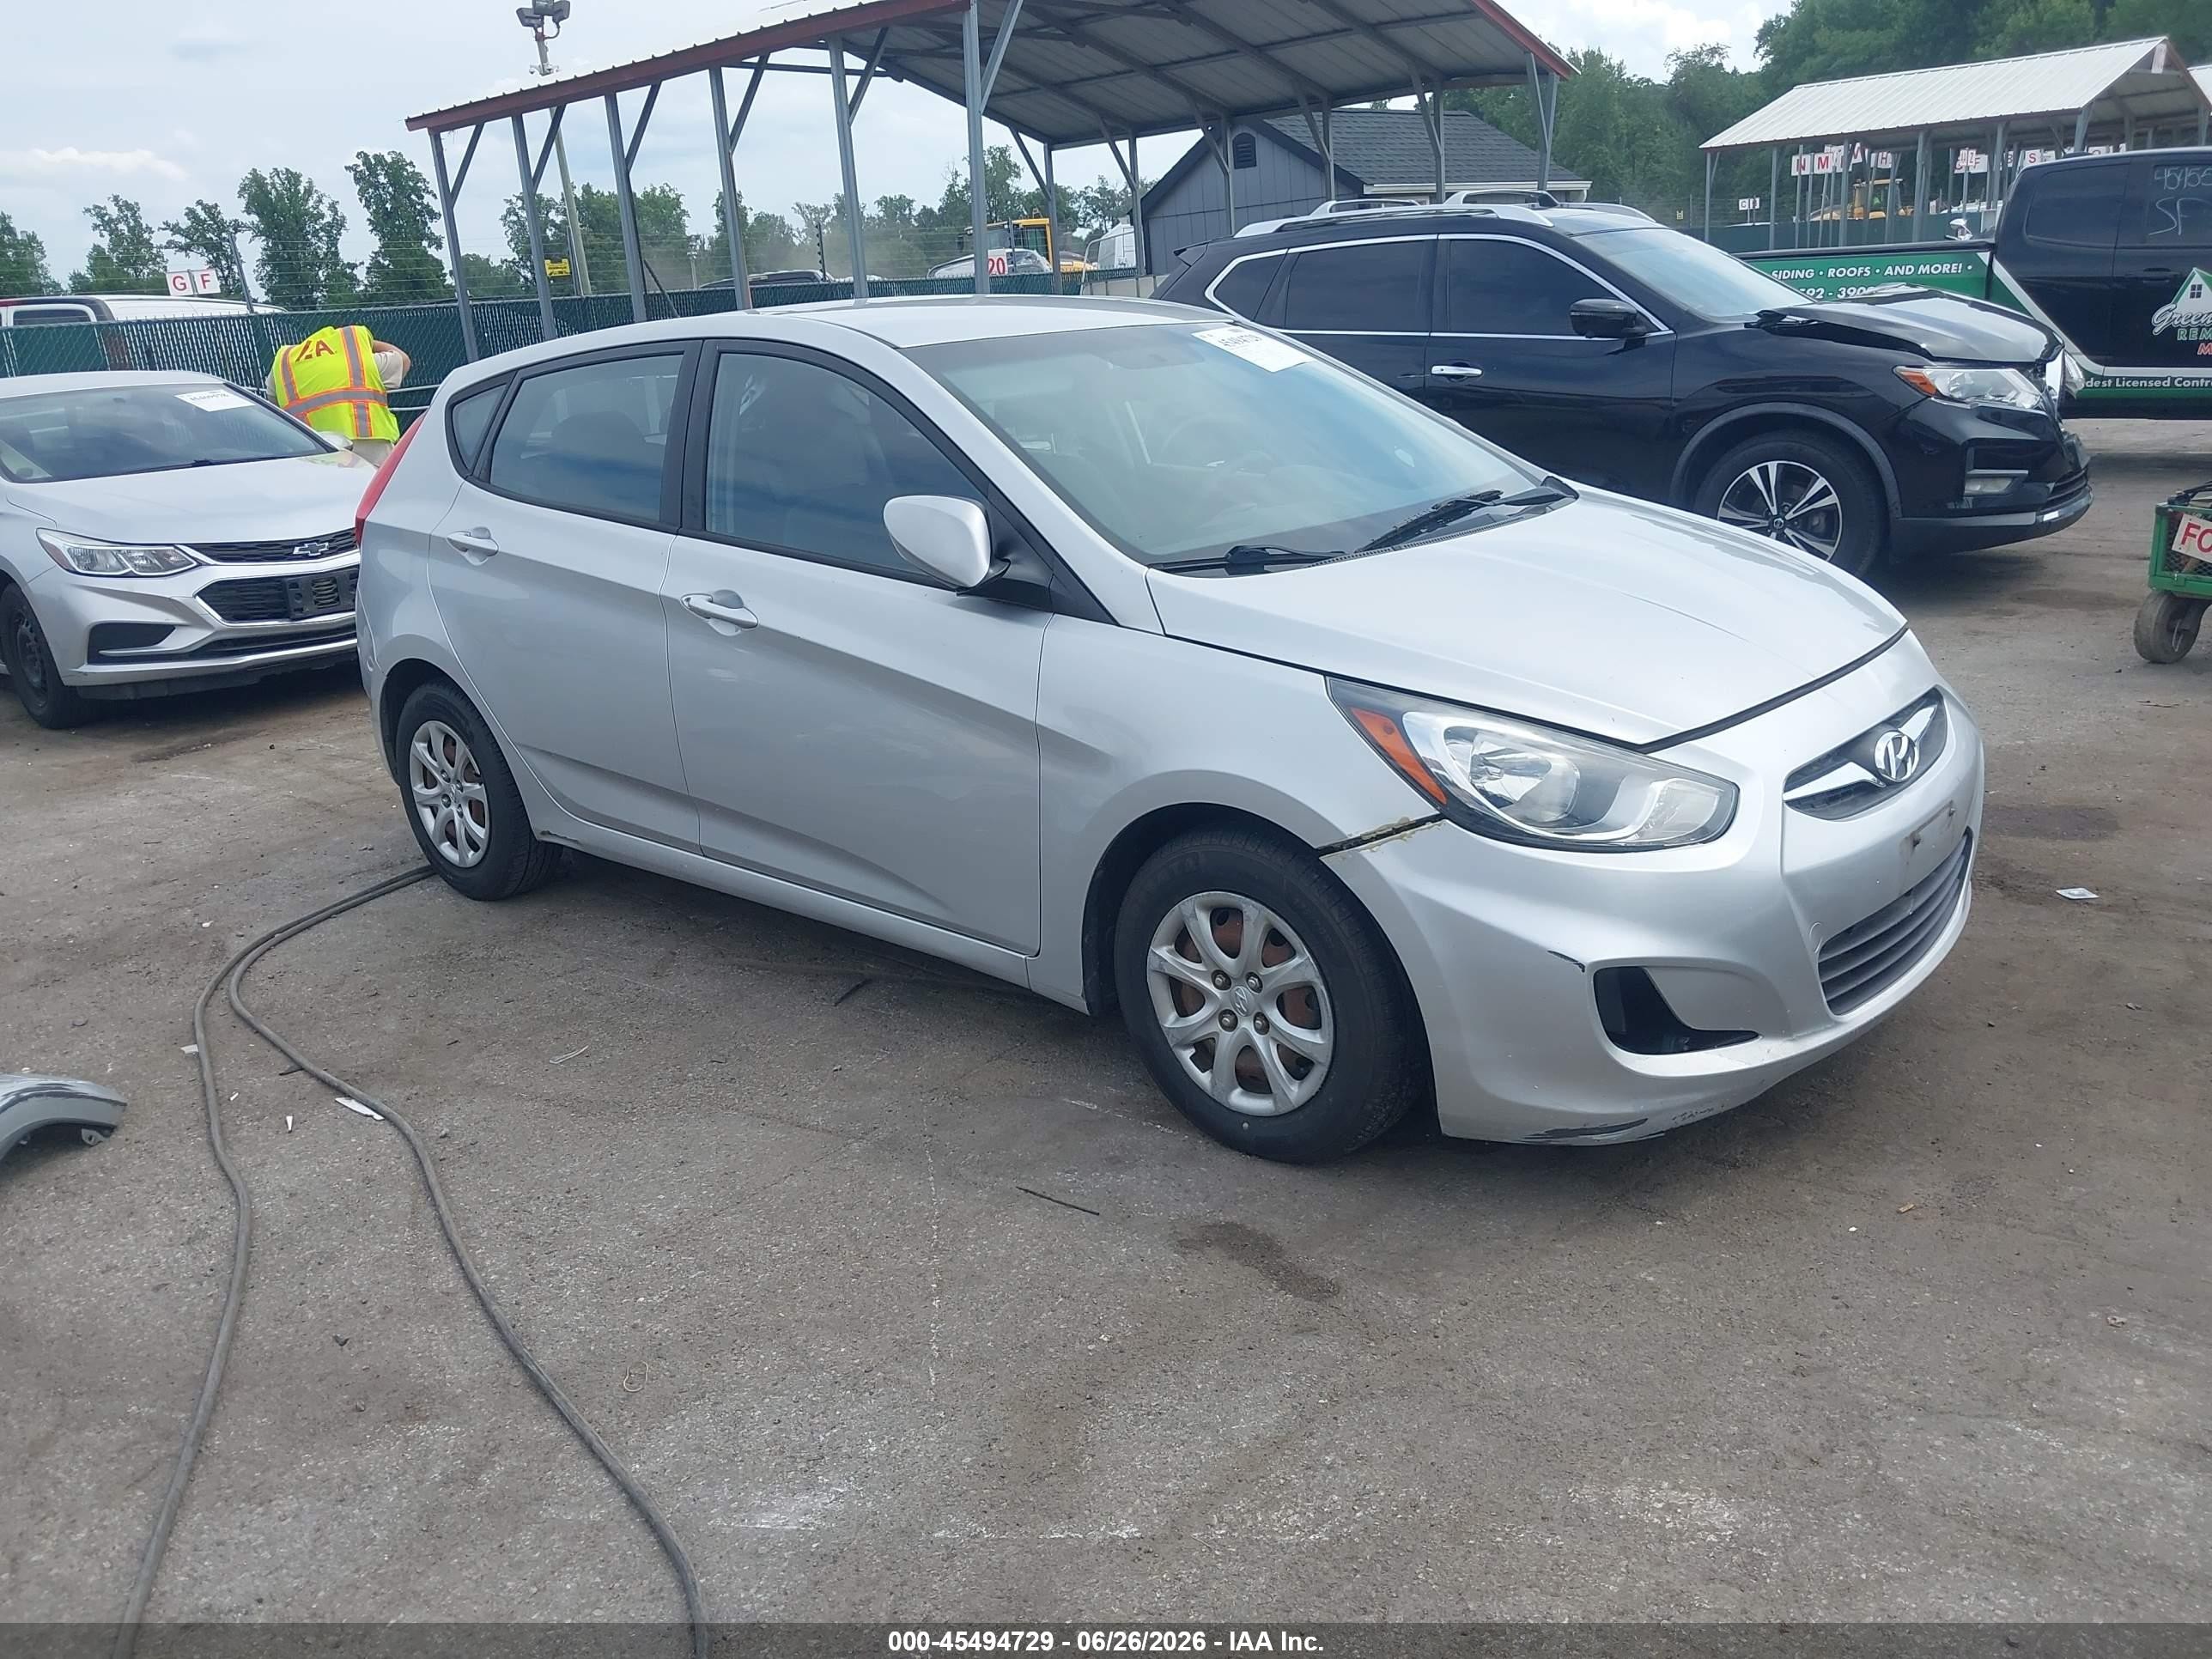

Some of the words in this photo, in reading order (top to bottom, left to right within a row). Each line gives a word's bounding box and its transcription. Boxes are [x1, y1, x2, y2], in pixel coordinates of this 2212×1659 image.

[1796, 156, 1806, 173] N
[1817, 156, 1829, 170] M
[2028, 153, 2037, 163] S
[988, 258, 1006, 275] 20
[1771, 269, 1815, 281] SIDING
[1827, 266, 1871, 278] ROOFS
[1884, 264, 1915, 276] AND
[1917, 263, 1962, 275] MORE!
[173, 275, 186, 291] G
[200, 273, 210, 289] F
[2177, 328, 2212, 340] REM
[2085, 377, 2112, 387] dest
[2115, 376, 2171, 387] Licensed
[2174, 378, 2212, 387] Contr
